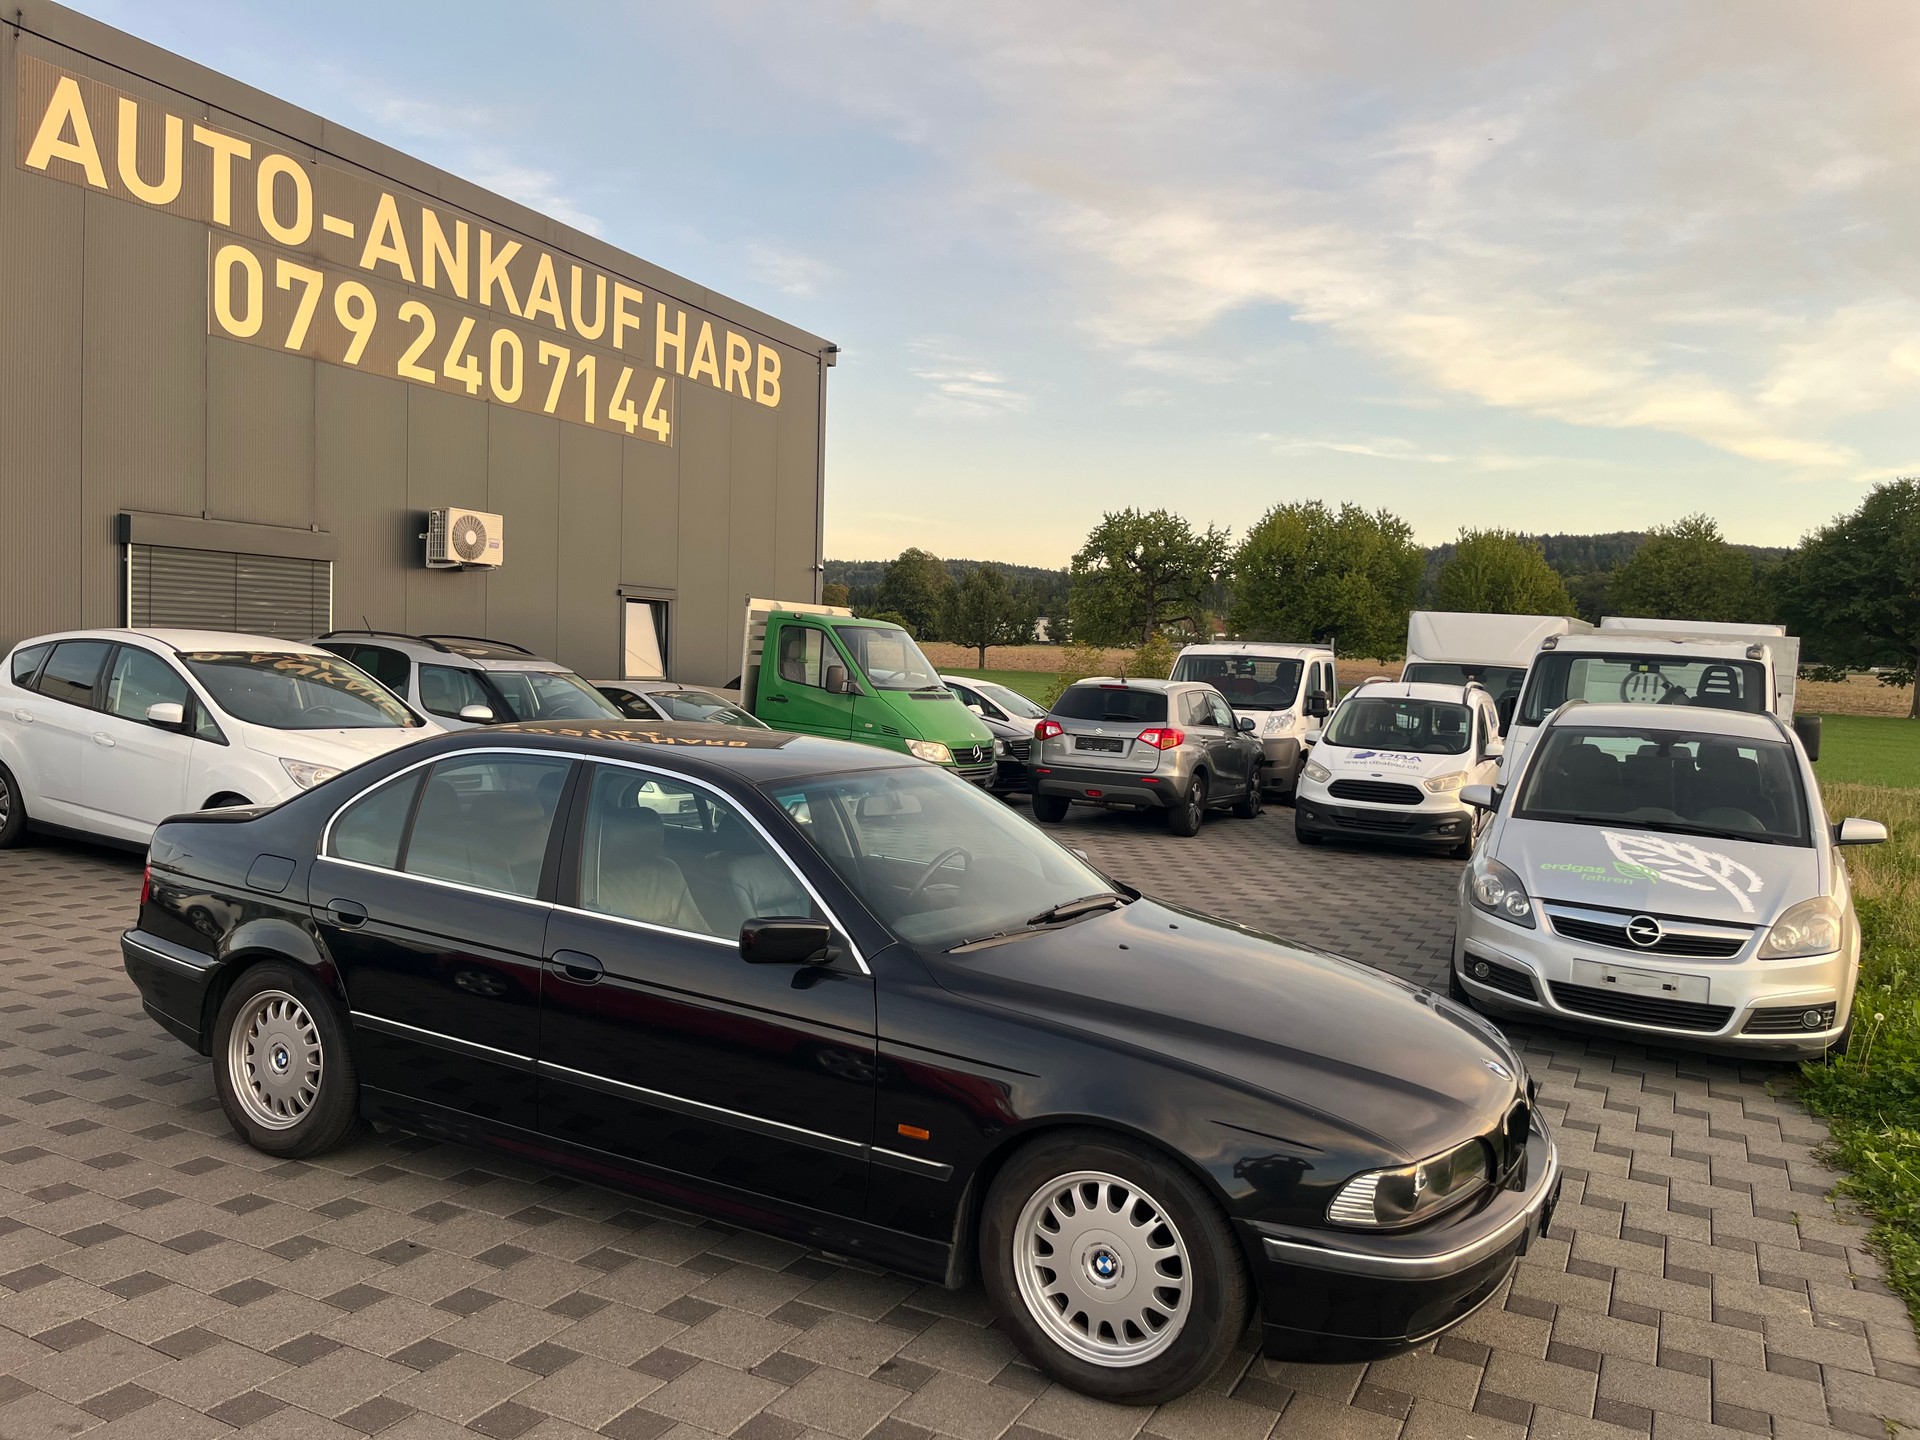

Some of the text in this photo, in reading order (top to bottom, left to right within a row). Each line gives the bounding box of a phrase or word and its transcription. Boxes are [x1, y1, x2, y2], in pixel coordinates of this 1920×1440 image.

[25, 76, 781, 408] AUTO-ANKAUF HARB
[214, 244, 671, 442] 079 240 7144
[1379, 753, 1422, 762] DBA
[1344, 760, 1419, 770] www.dbabau.ch
[1540, 863, 1606, 873] erdgas
[1581, 873, 1633, 885] fahren
